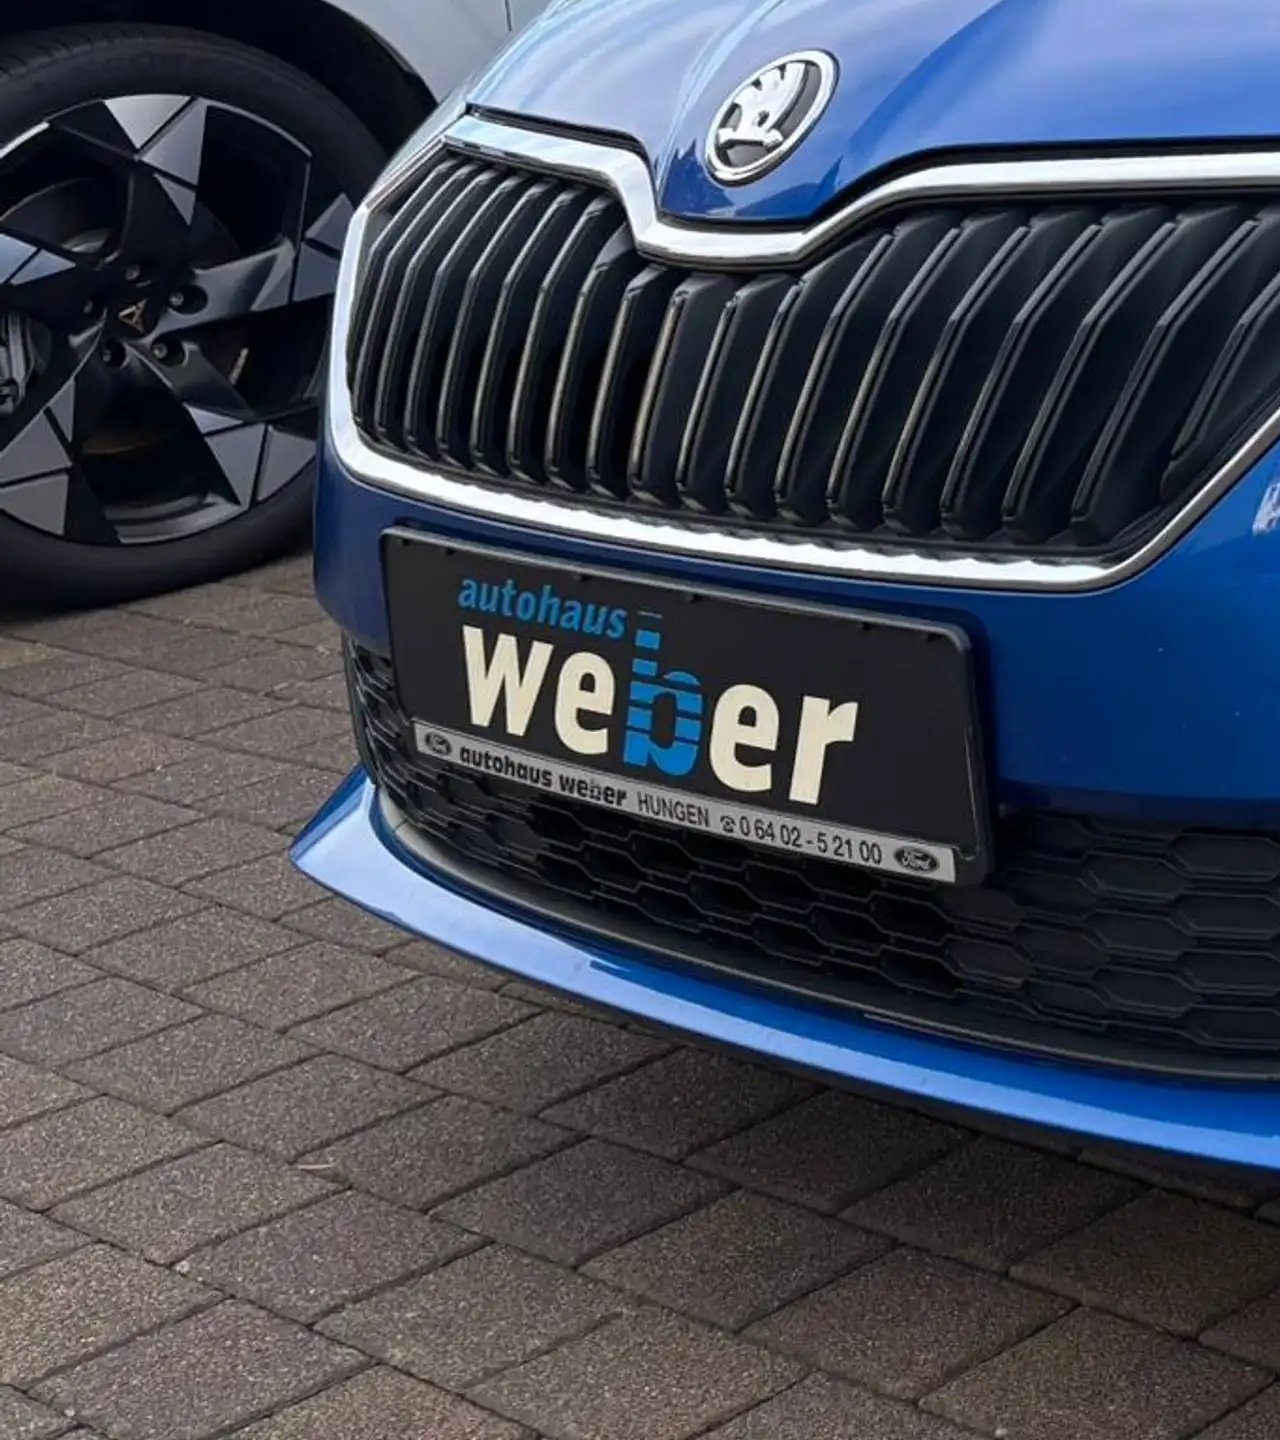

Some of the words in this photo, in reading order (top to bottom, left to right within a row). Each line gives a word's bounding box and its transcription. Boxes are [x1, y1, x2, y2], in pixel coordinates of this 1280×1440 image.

[458, 578, 628, 639] autohaus
[461, 612, 858, 806] weber
[460, 746, 552, 787] autohaus
[559, 773, 628, 806] weber
[637, 792, 710, 828] HUNGEN
